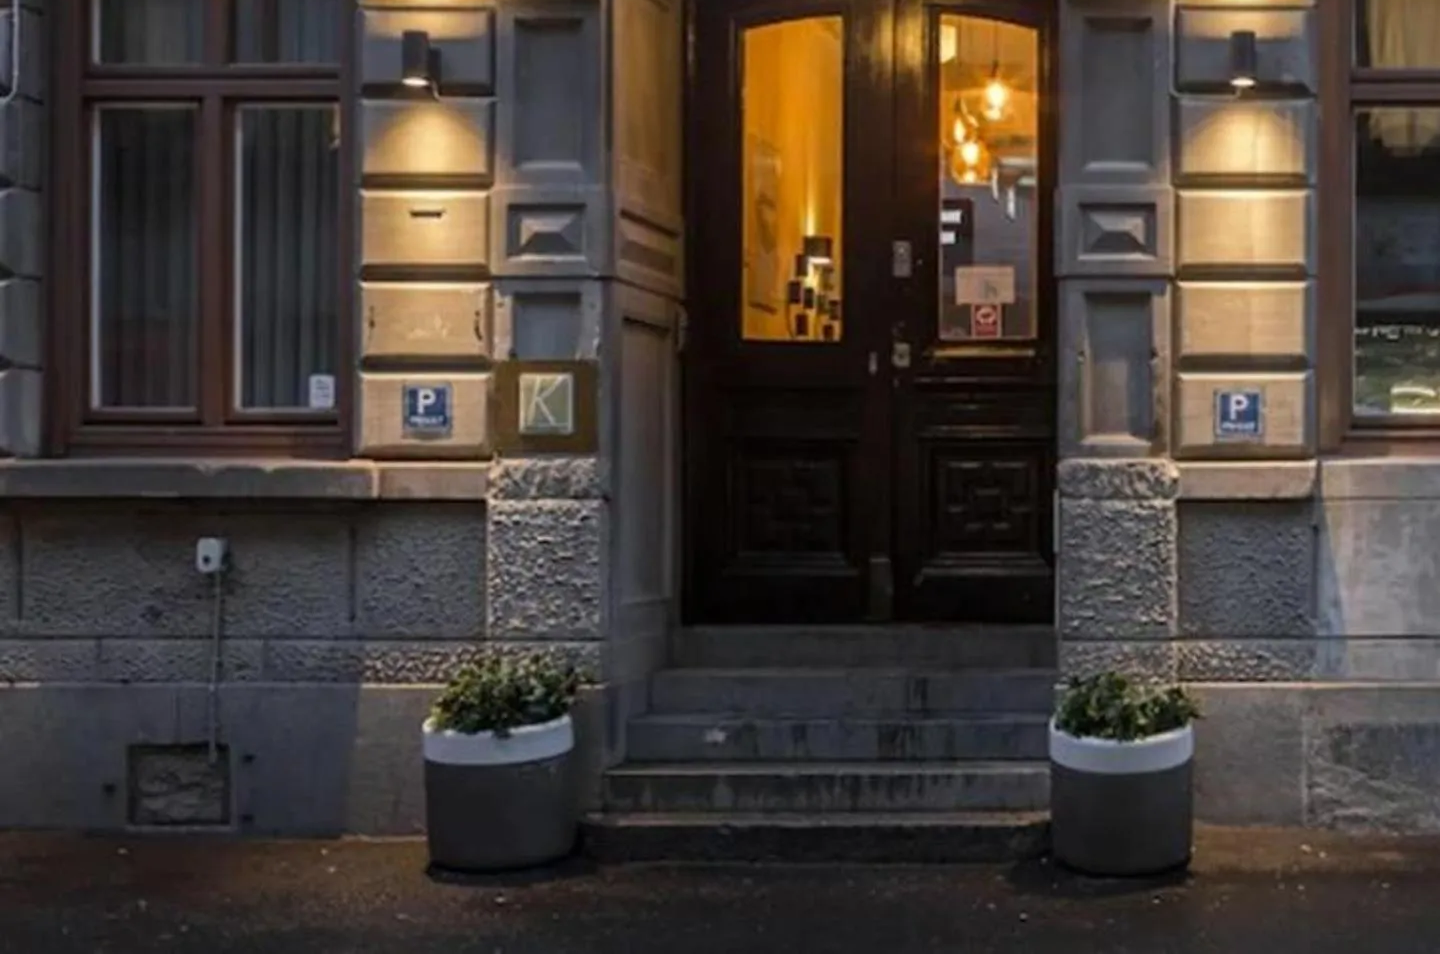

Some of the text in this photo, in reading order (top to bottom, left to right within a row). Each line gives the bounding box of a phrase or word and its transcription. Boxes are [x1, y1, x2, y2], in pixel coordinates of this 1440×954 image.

[417, 388, 436, 414] P
[528, 375, 567, 426] K
[1230, 393, 1249, 420] P
